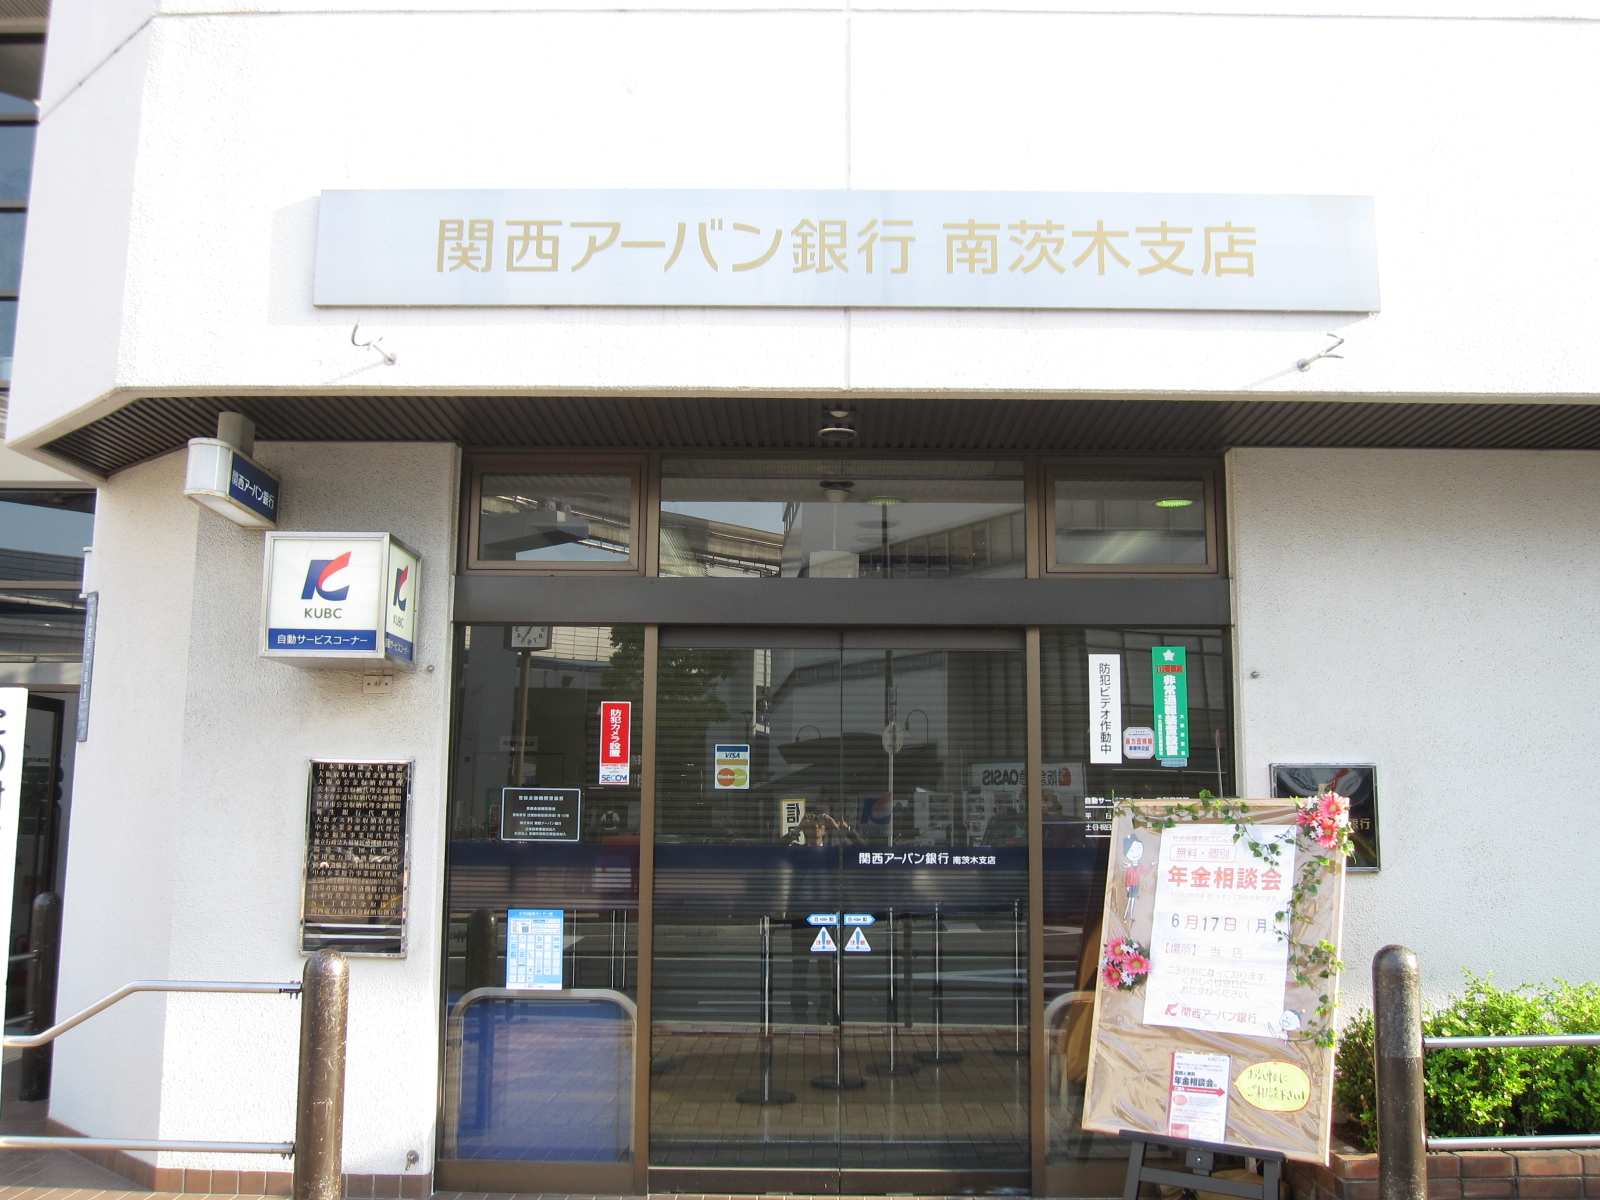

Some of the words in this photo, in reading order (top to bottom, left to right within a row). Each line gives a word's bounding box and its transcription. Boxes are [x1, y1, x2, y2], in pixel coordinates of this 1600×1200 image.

[437, 218, 916, 273] 関西アーバン銀行
[942, 218, 1257, 276] 南茨木支店
[232, 470, 275, 509] 関西アーバン銀行
[304, 608, 342, 619] KUBC
[393, 614, 404, 628] KUBC
[277, 634, 368, 645] 自動サービスコーナー
[1098, 663, 1112, 755] 防犯ビデオ作動中
[609, 708, 622, 758] 防犯カメラ設置
[601, 774, 628, 782] SECOM
[858, 852, 950, 865] 関西アーバン銀行
[952, 855, 996, 865] 南茨木支店
[1175, 847, 1231, 860] 無料・個別
[1168, 865, 1282, 891] 年金相談会
[1180, 1005, 1258, 1024] 関西アーバン銀行
[1247, 1068, 1288, 1084] お気軽に
